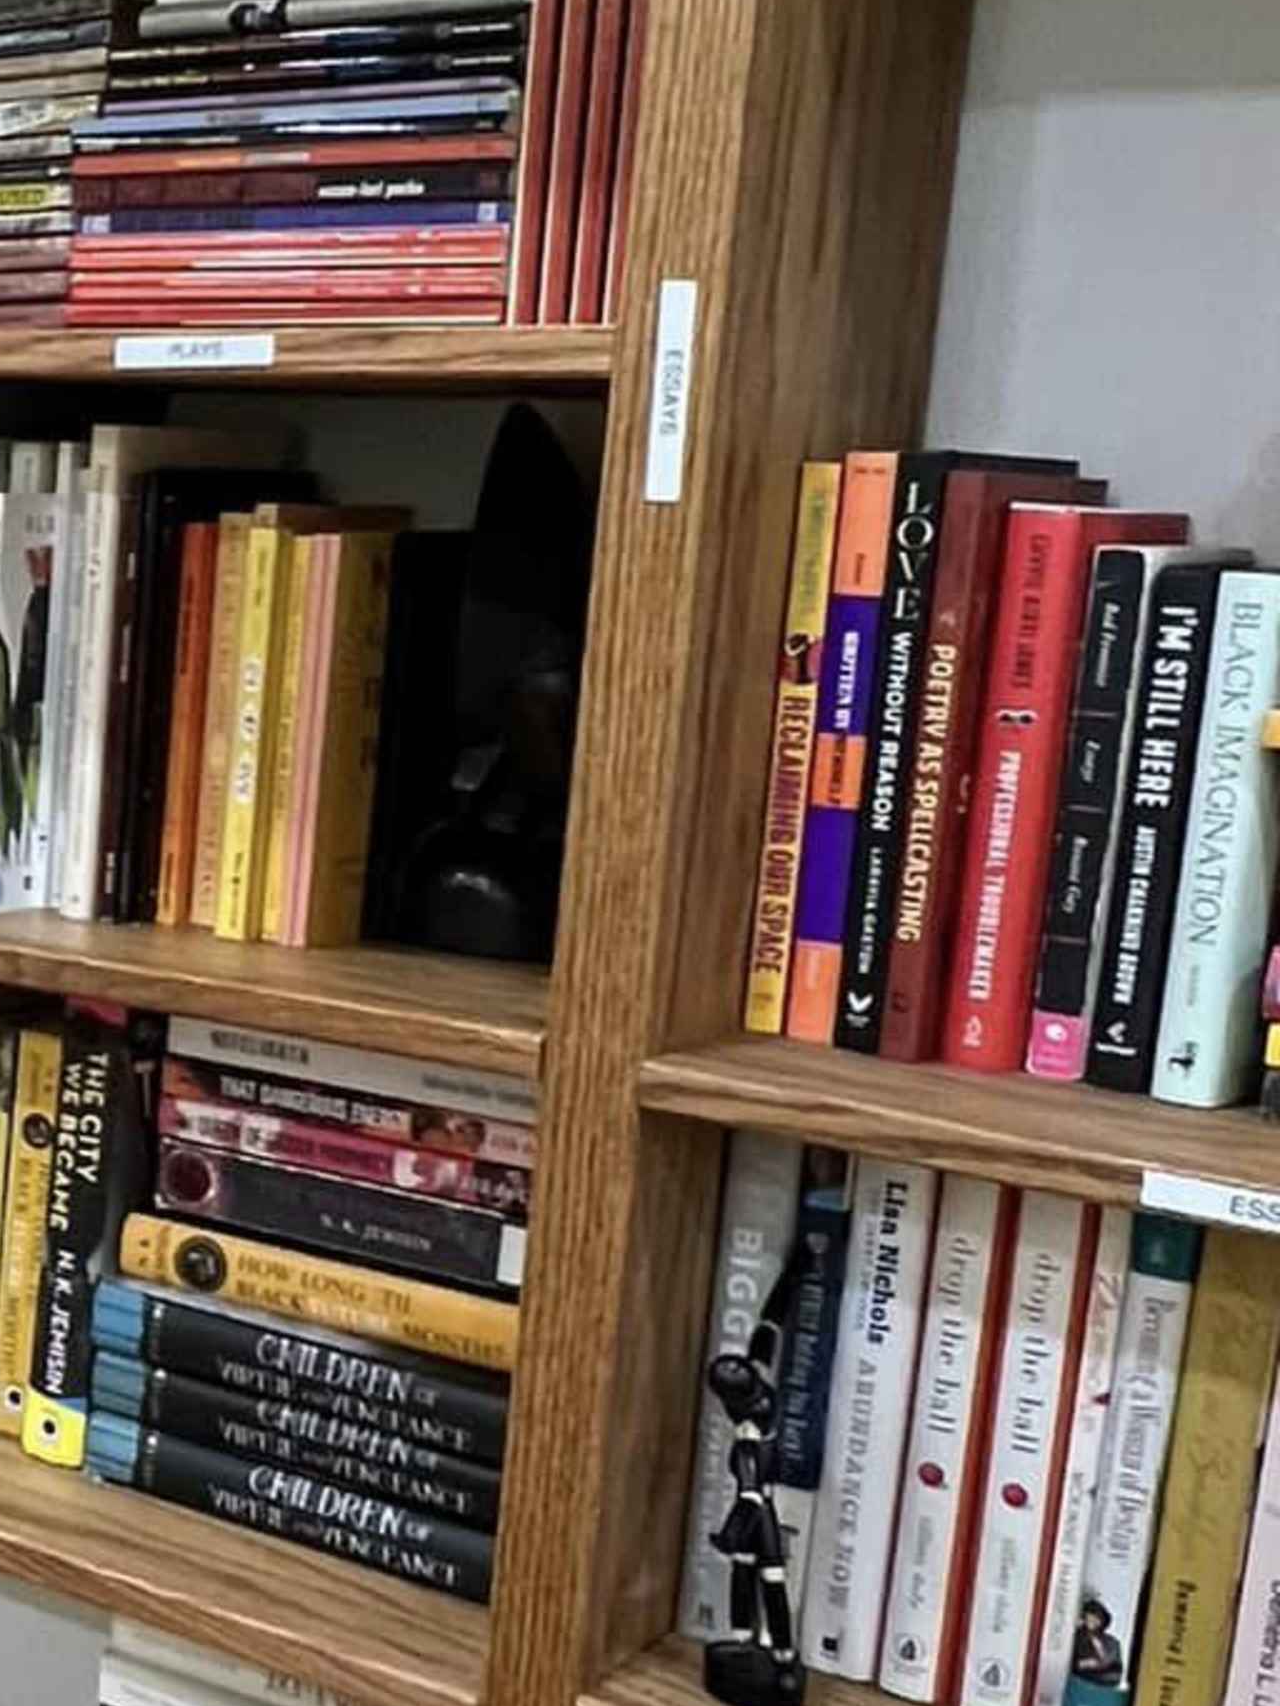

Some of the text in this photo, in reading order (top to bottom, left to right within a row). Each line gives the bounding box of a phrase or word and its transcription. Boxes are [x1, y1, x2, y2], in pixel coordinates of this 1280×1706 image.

[871, 482, 934, 832] LOVE WITHOUT REASON
[1157, 606, 1199, 653] I'M
[1144, 658, 1188, 731] STILL
[1133, 738, 1178, 809] HERE
[1186, 601, 1263, 946] BLACK IMAGINATION
[62, 1063, 82, 1108] WE
[75, 1052, 109, 1184] THE CITY
[50, 1112, 79, 1232] BECAME
[880, 1180, 909, 1236] Lisa
[299, 1267, 369, 1304] LONG
[867, 1238, 901, 1346] Nichols
[257, 1333, 415, 1401] CHILDREN
[937, 1316, 969, 1366] the
[1023, 1334, 1052, 1385] the
[926, 1374, 963, 1434] ball
[1012, 1394, 1048, 1455] ball
[249, 1462, 403, 1536] CHILDREN
